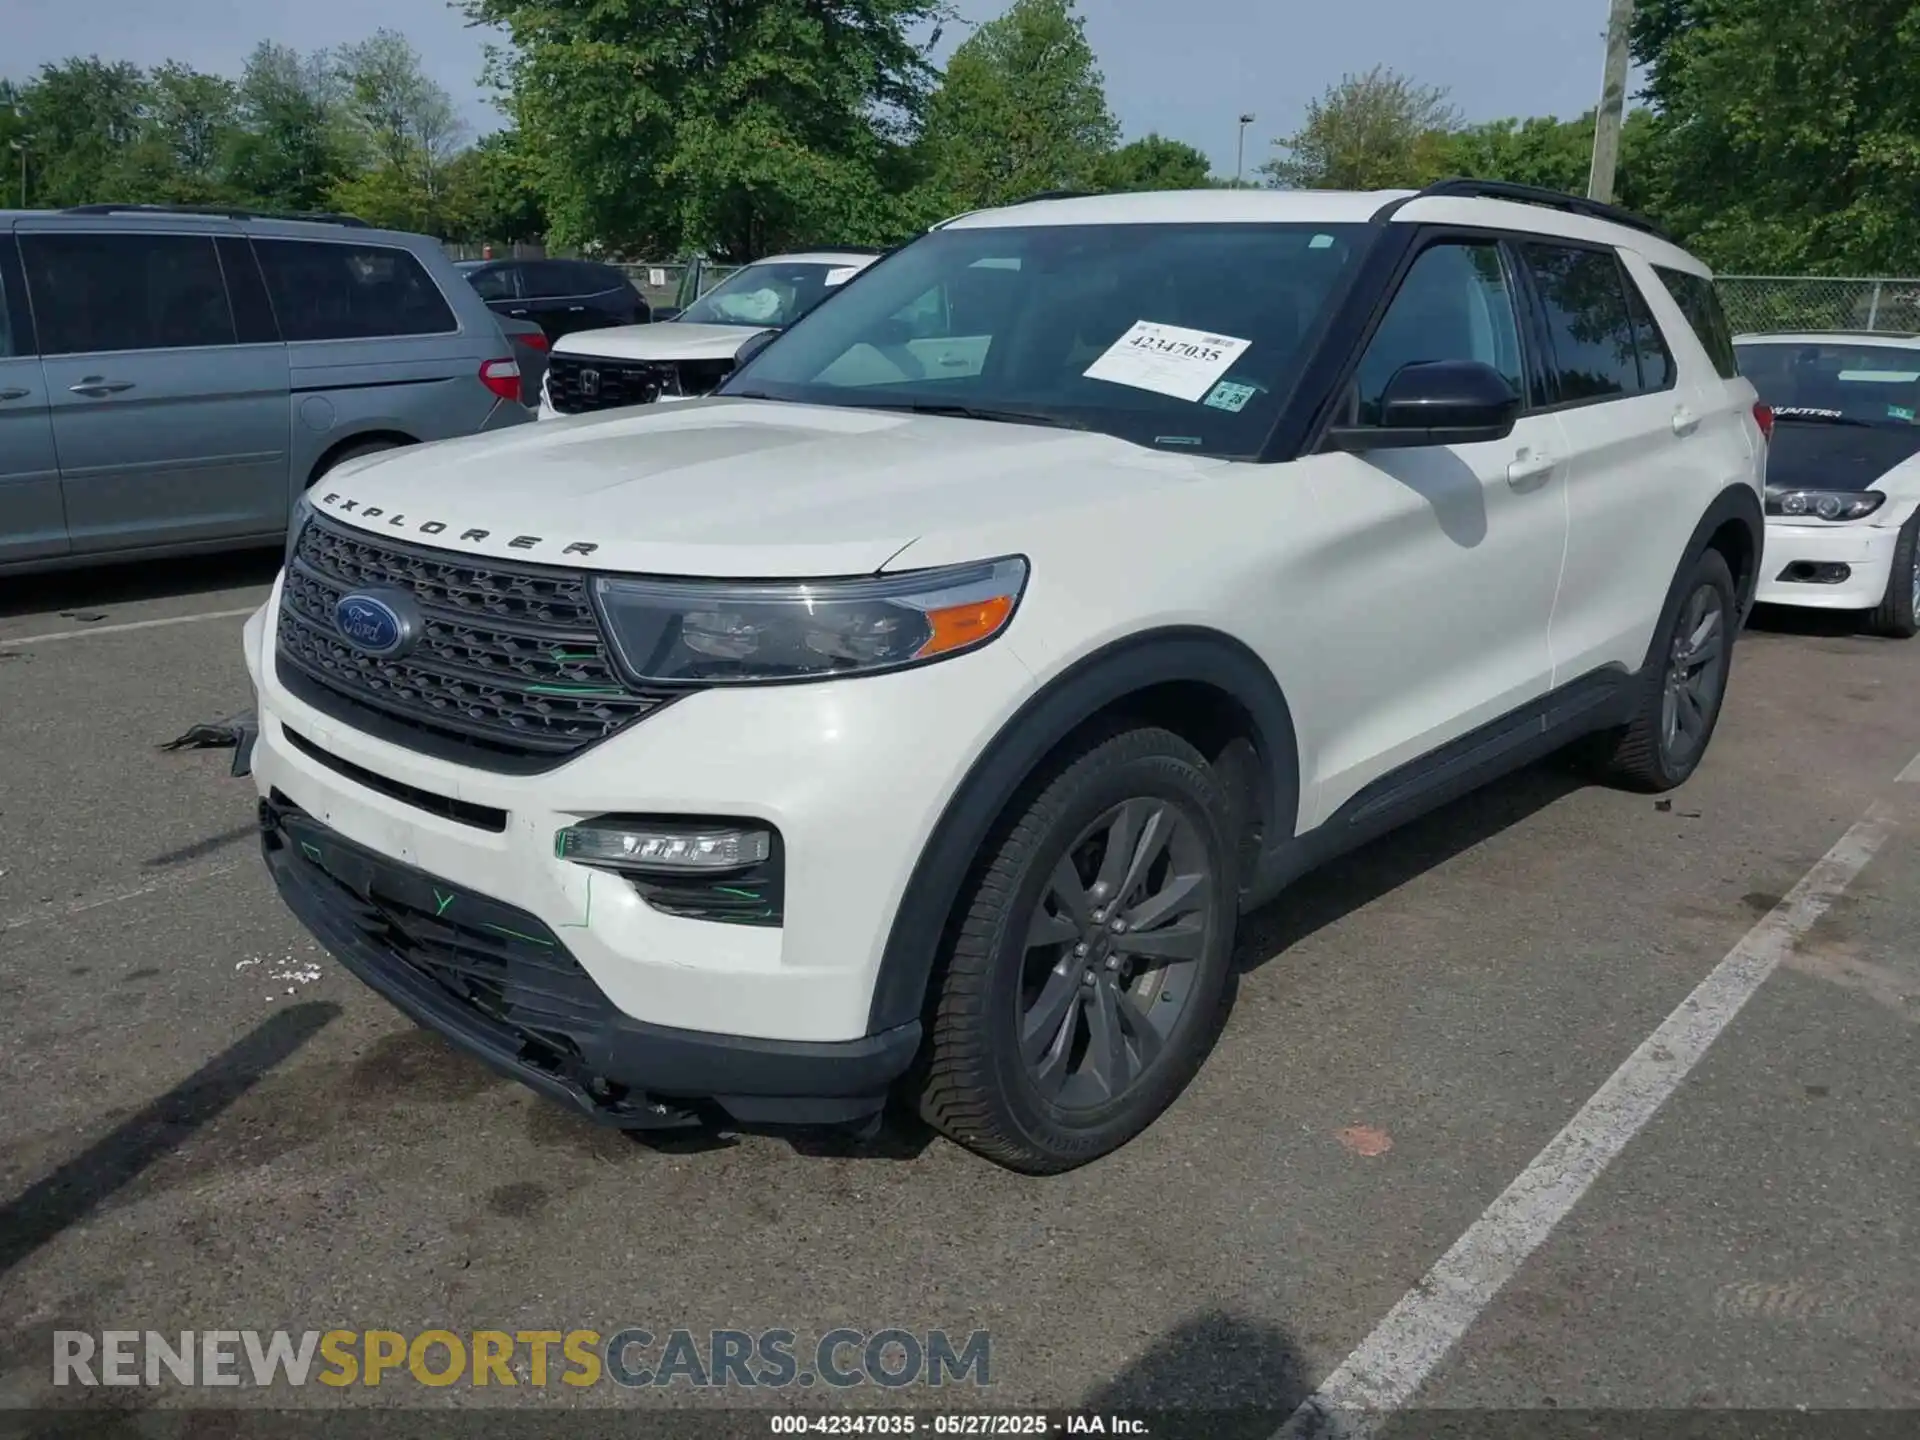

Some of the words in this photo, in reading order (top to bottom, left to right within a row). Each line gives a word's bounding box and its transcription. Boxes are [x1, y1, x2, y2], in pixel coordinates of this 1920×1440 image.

[1130, 335, 1222, 362] 42347035
[322, 492, 600, 556] EXPLORER
[343, 604, 384, 643] Ford
